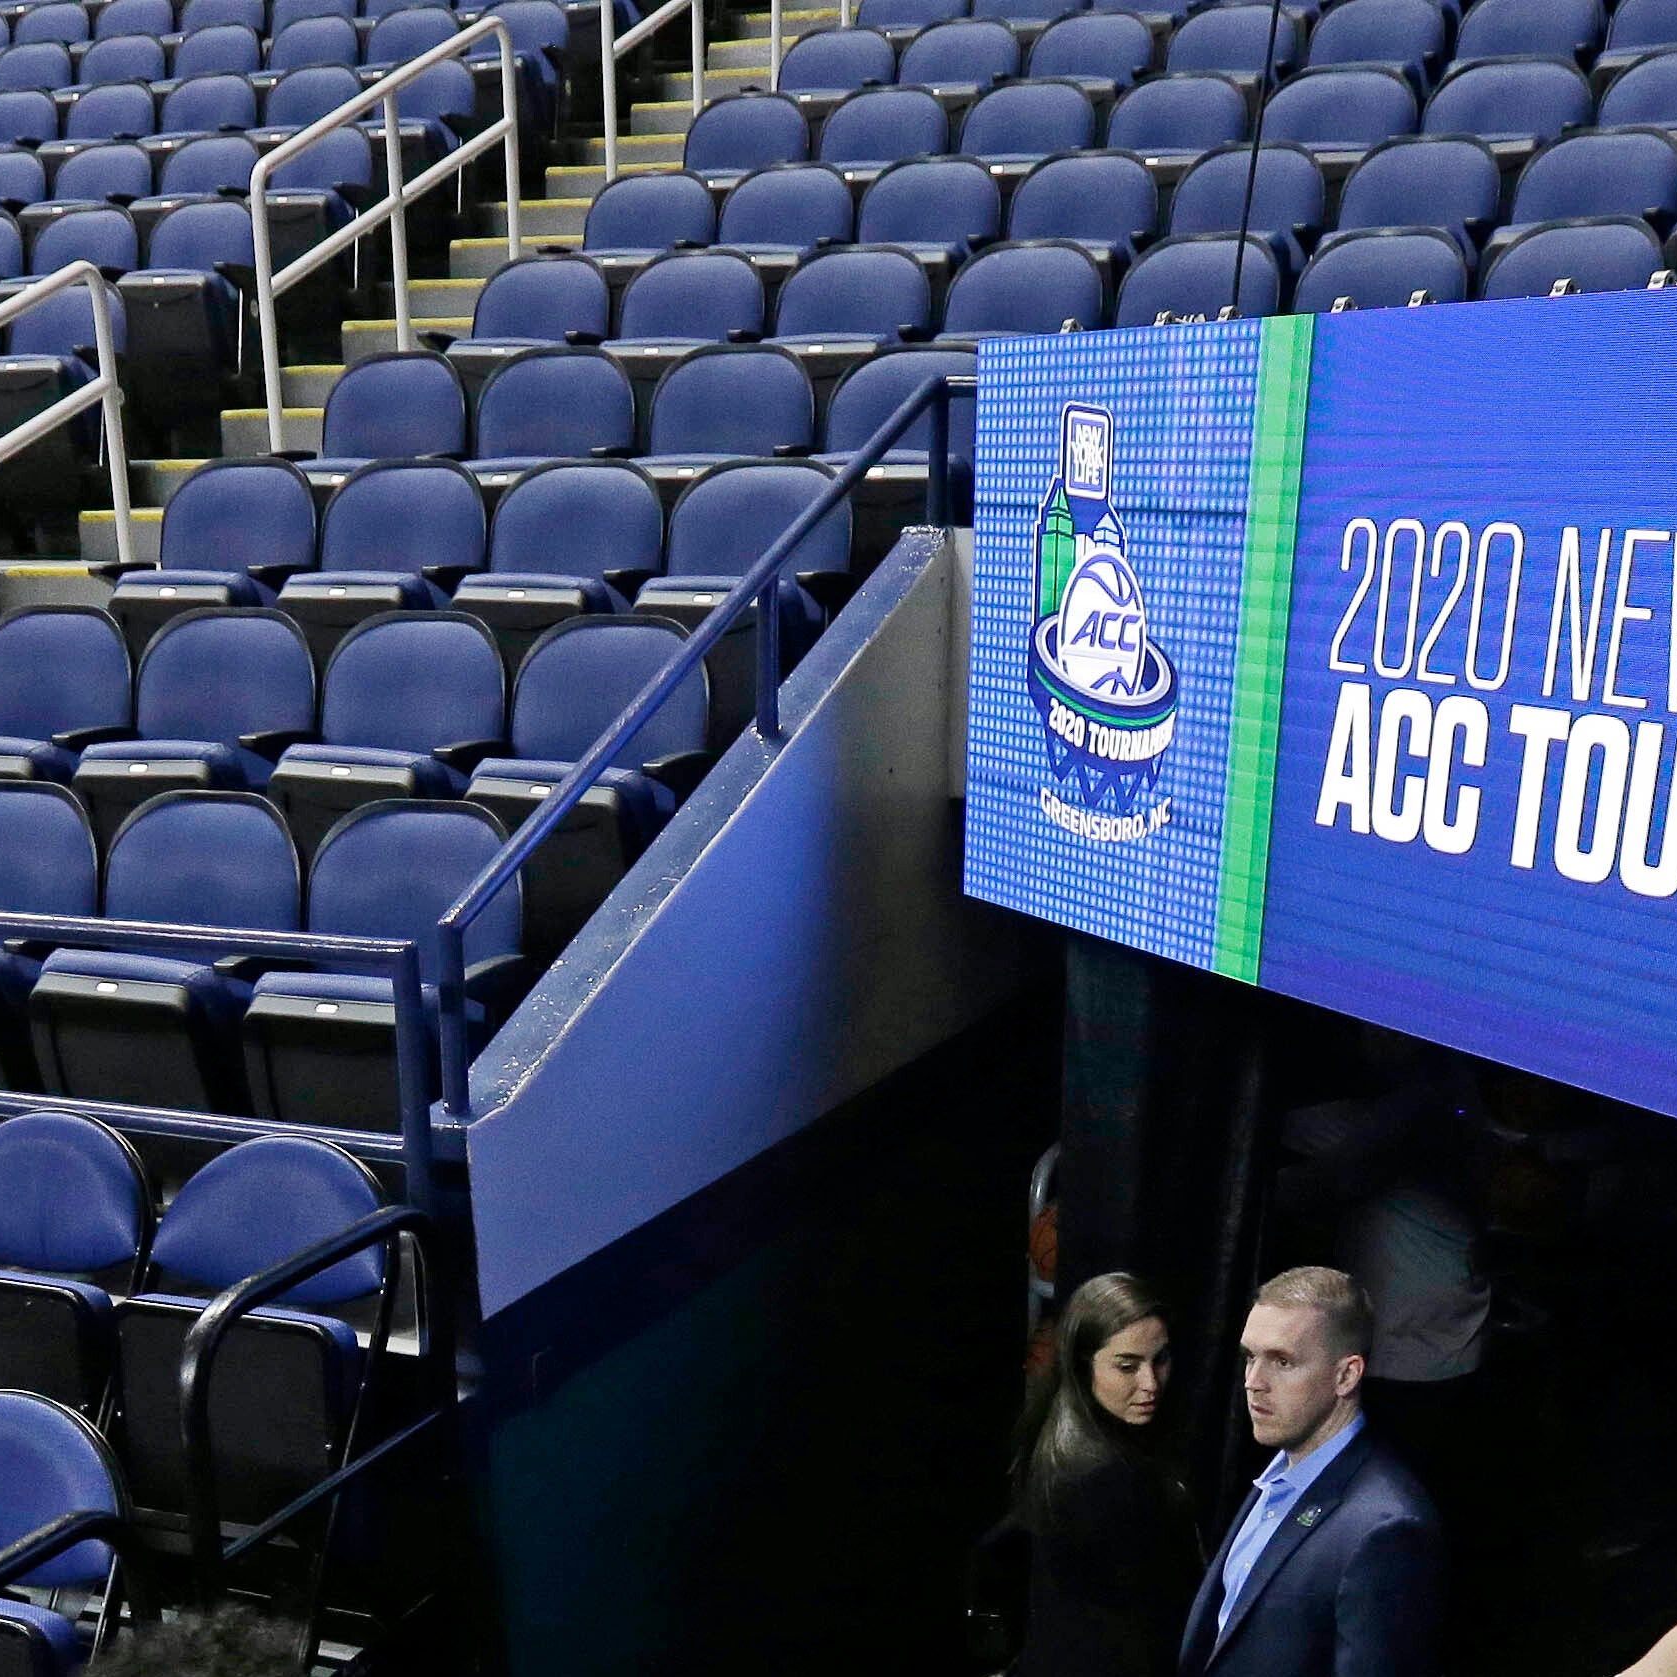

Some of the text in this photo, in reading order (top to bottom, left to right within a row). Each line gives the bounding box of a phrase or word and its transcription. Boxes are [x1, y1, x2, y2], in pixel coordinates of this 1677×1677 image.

[1071, 441, 1103, 467] YORK
[1075, 424, 1102, 449] NEW
[1074, 463, 1100, 485] LIFE
[1328, 516, 1525, 692] 2020
[1071, 609, 1140, 652] ACC
[1049, 697, 1085, 748] 2020
[1314, 682, 1489, 856] ACC
[1040, 787, 1172, 842] GREENSBORO, NC
